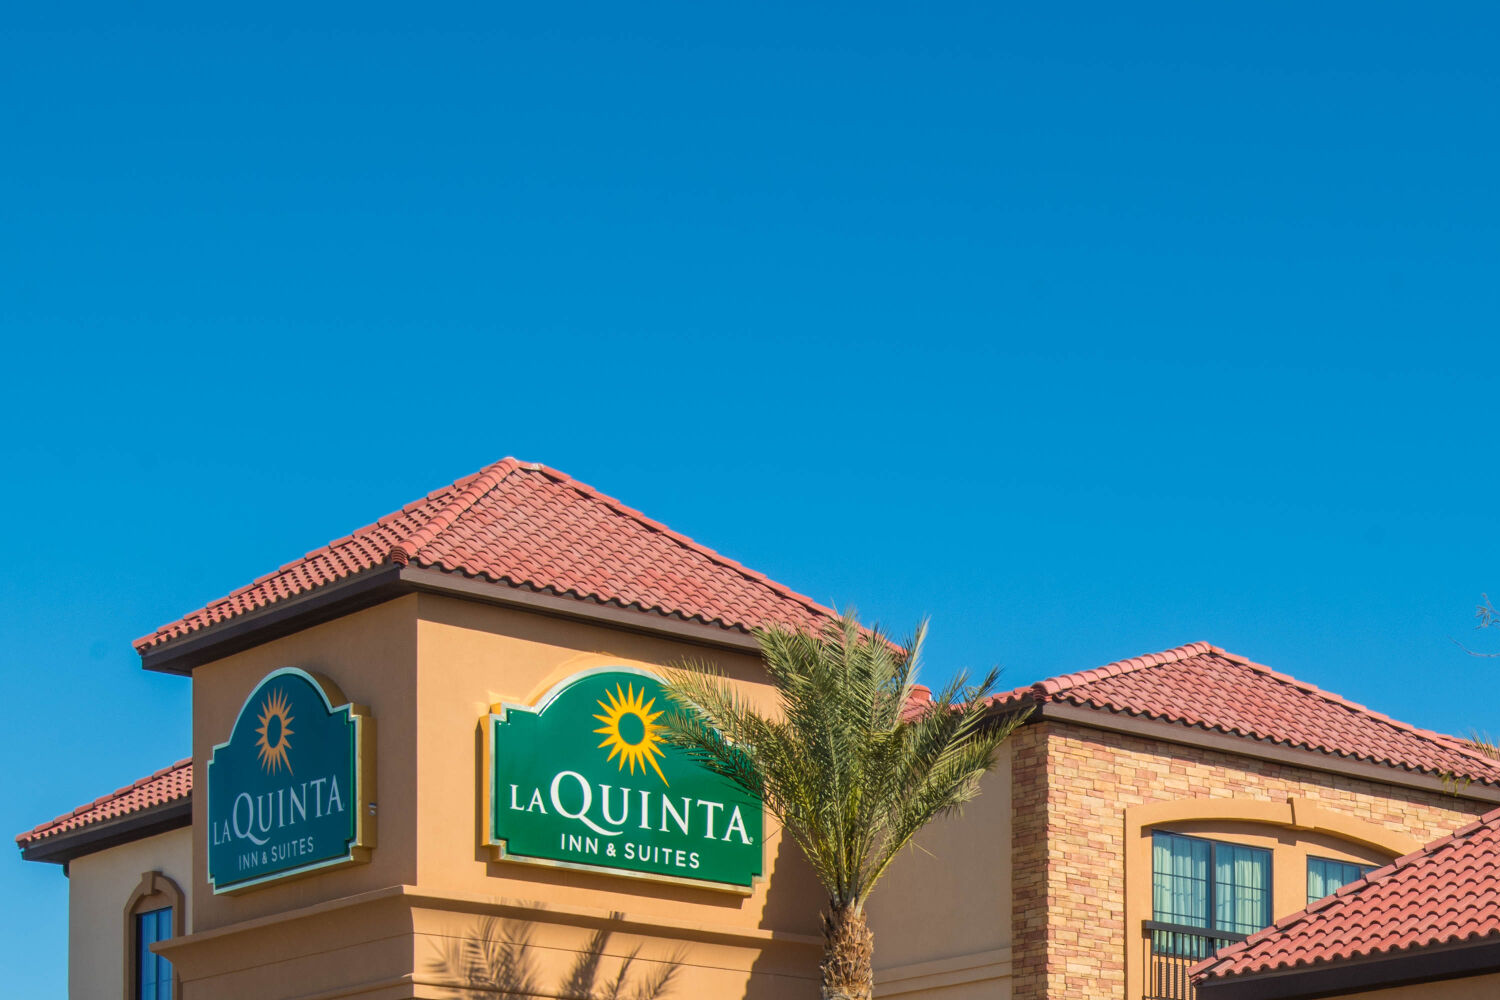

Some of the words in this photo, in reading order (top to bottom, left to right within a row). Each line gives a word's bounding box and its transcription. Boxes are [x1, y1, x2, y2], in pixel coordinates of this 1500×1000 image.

[213, 819, 232, 846] LA
[233, 774, 344, 846] QUINTA
[510, 784, 548, 815] LA
[550, 770, 753, 845] QUINTA
[238, 851, 259, 871] INN
[261, 852, 268, 865] &
[271, 836, 314, 862] SUITES
[561, 833, 598, 855] INN
[606, 843, 617, 858] &
[624, 842, 700, 869] SUITES
